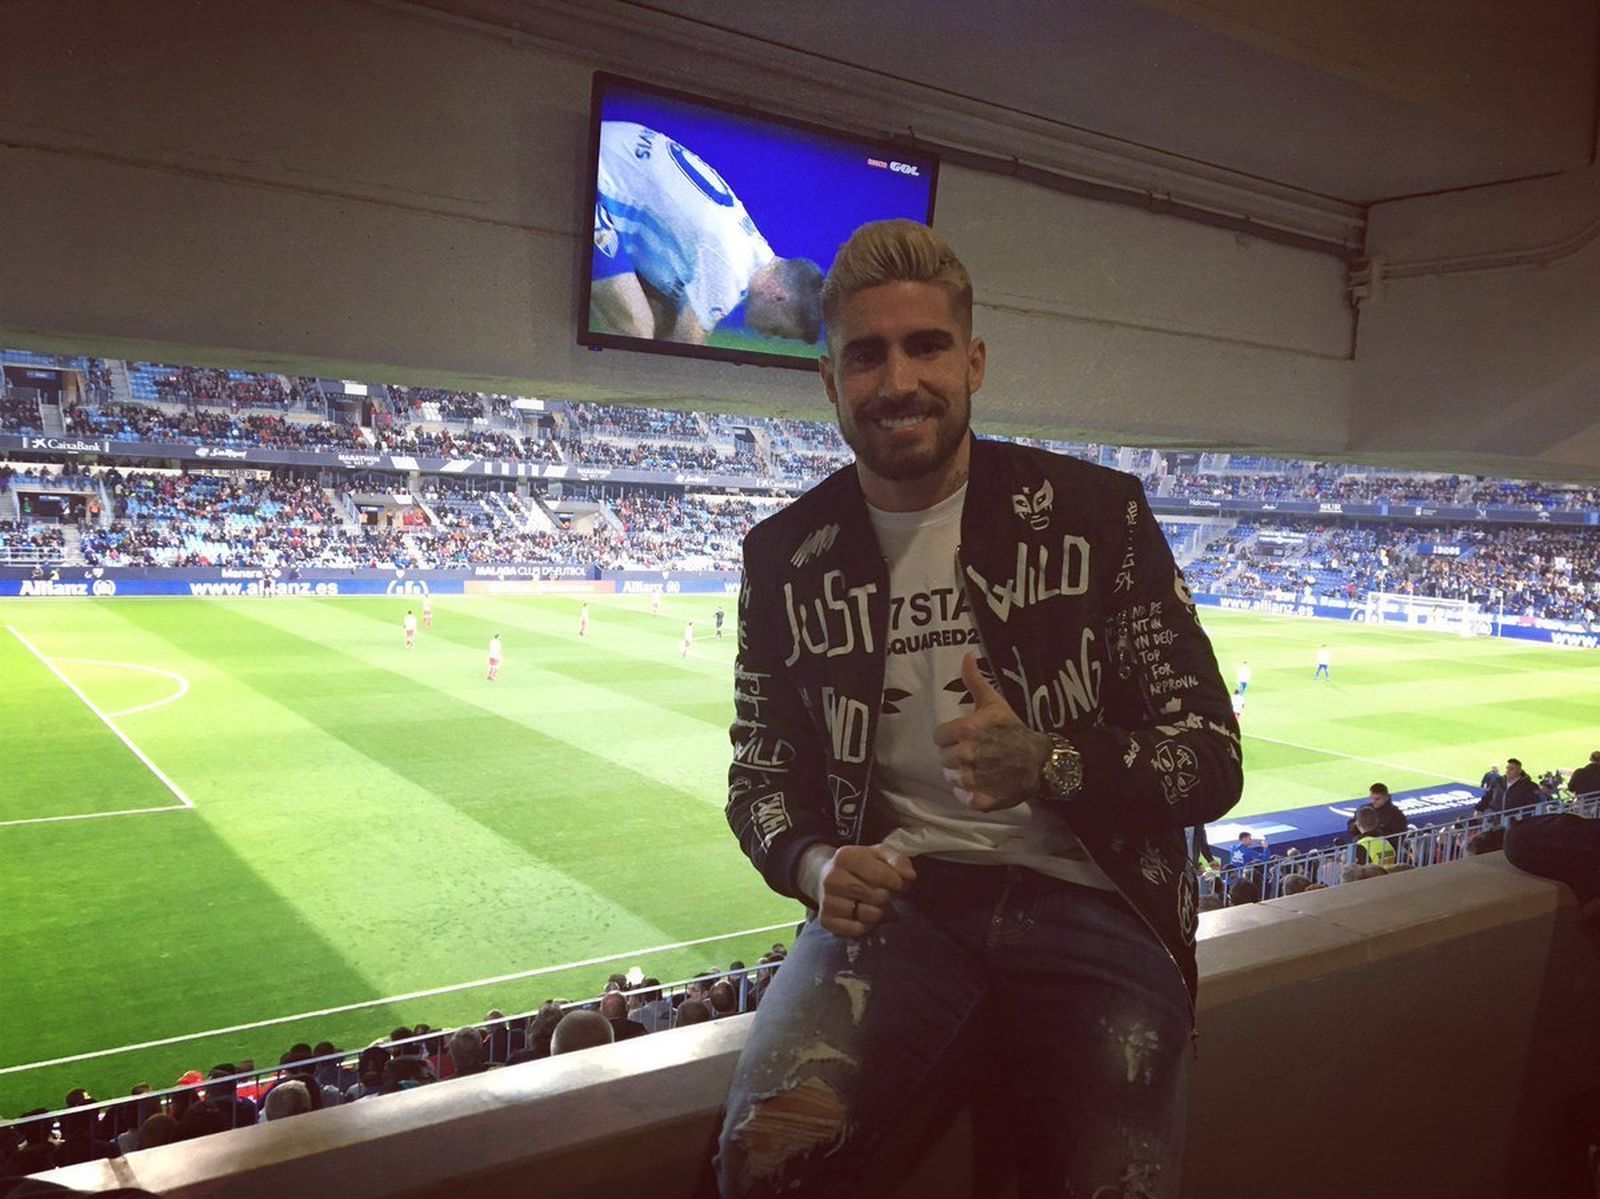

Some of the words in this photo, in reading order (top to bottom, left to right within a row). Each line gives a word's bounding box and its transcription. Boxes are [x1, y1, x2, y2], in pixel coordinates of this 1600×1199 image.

[890, 161, 920, 176] GOL
[47, 438, 102, 452] CaixaBank
[338, 454, 380, 463] MARATHON
[622, 580, 664, 593] Allianz
[967, 534, 1090, 622] WILD
[19, 579, 88, 596] Allianz
[1219, 598, 1315, 617] www.allianz.es
[784, 569, 877, 668] JUST
[1139, 649, 1161, 664] TOP
[1002, 627, 1101, 732] YOUNG
[1150, 662, 1174, 680] FOR
